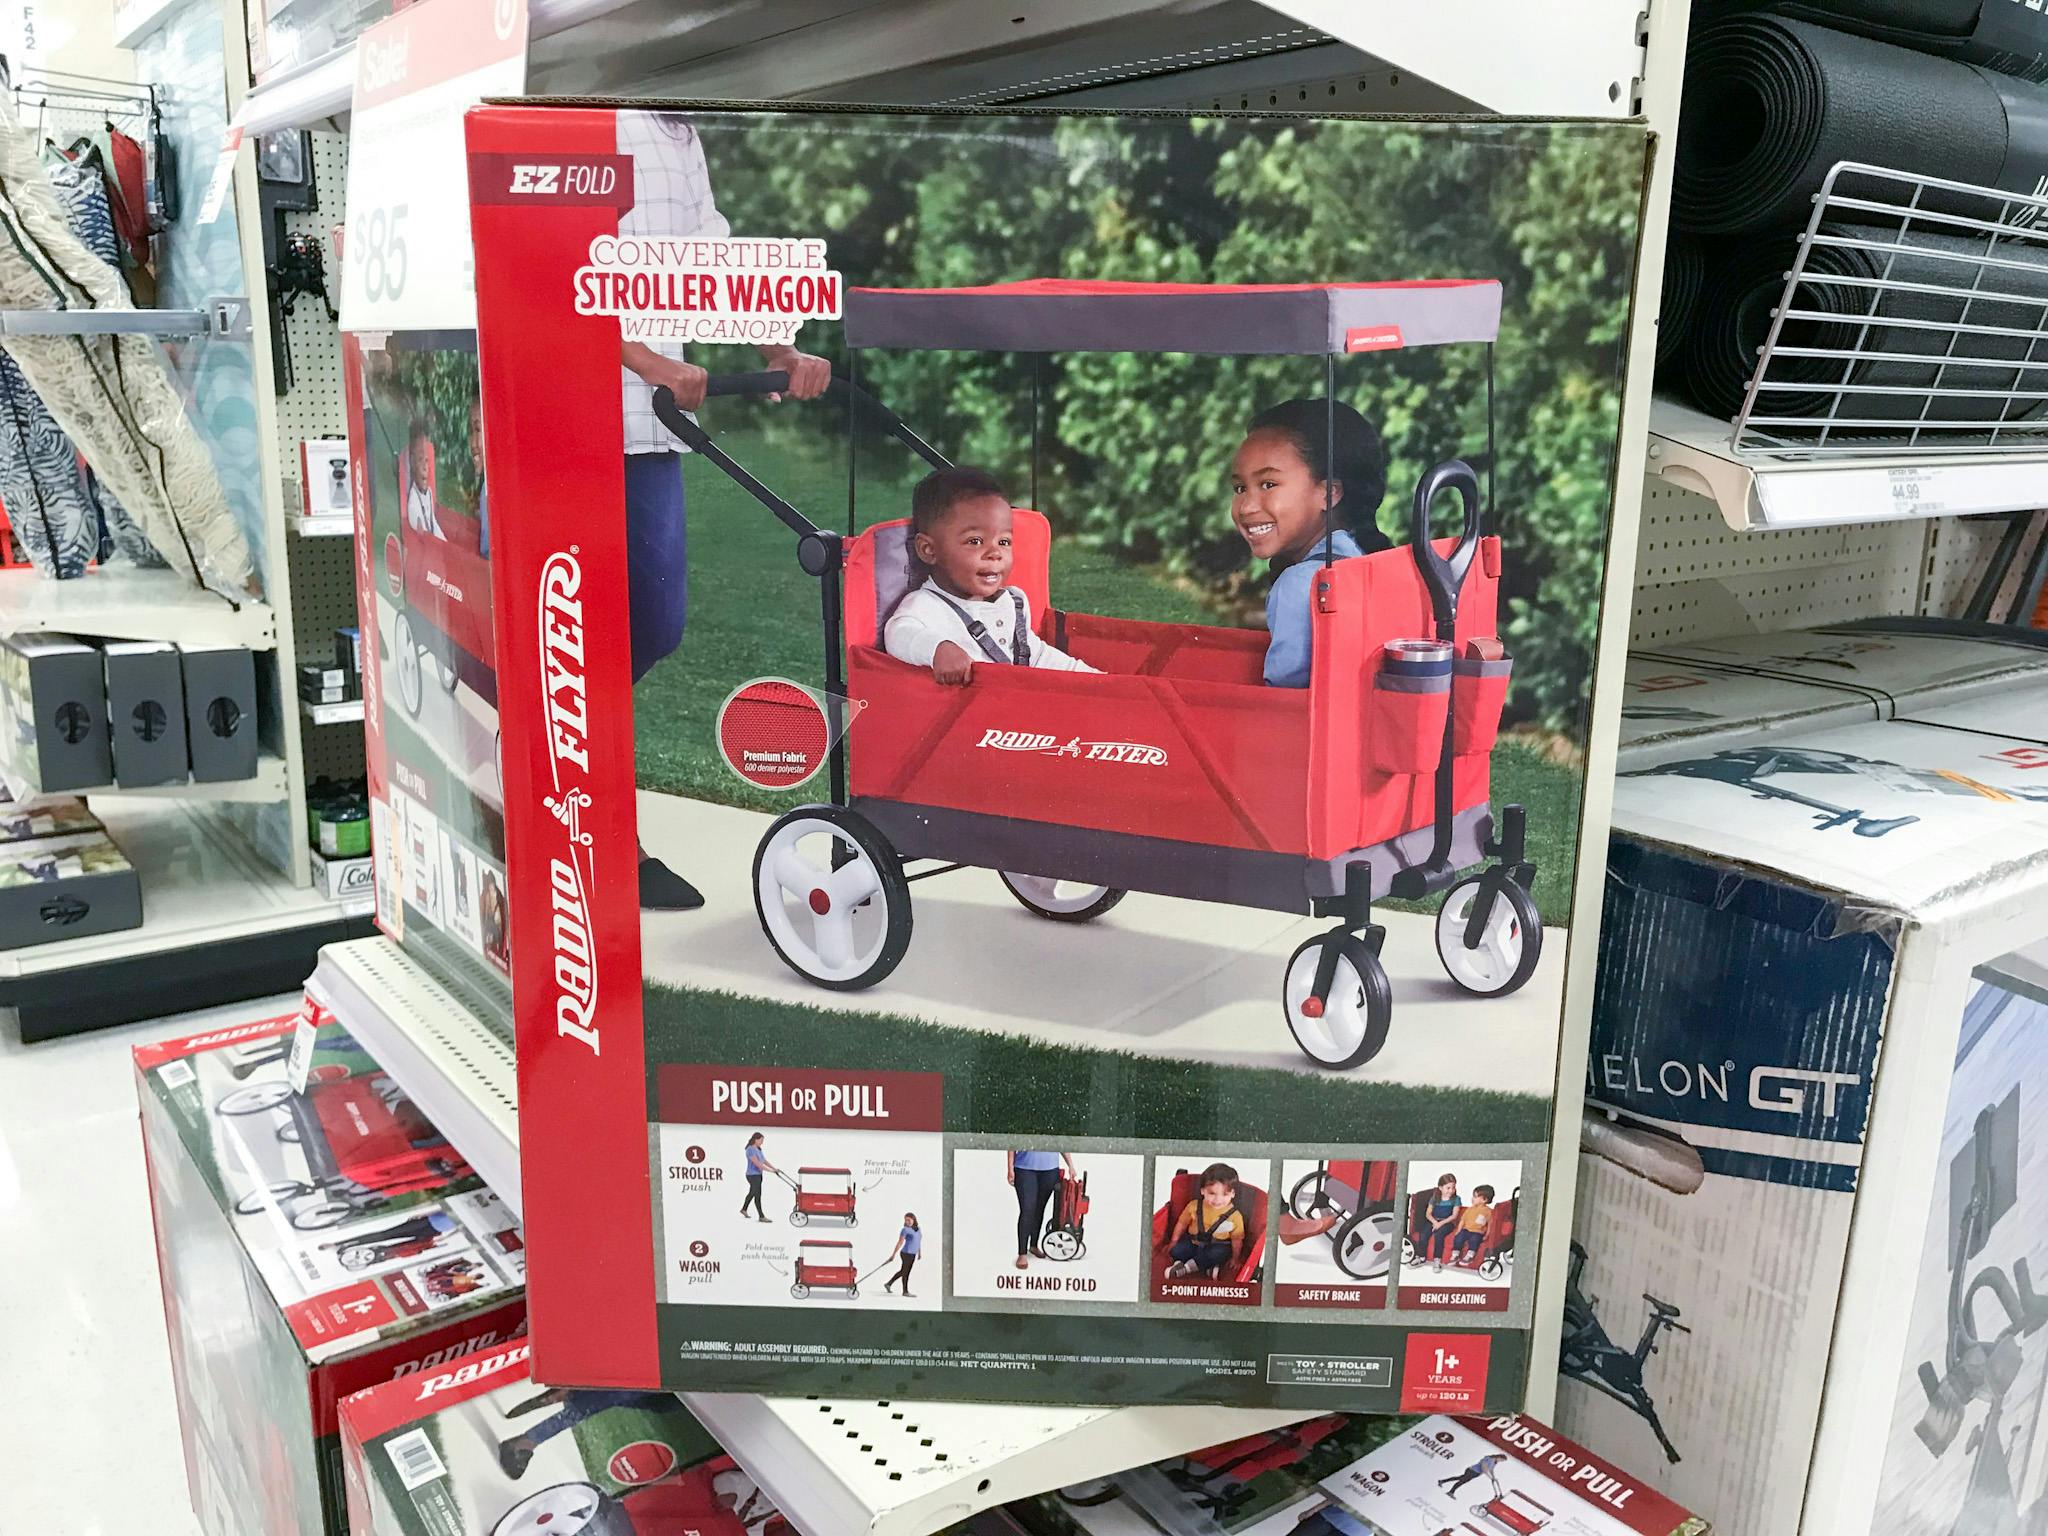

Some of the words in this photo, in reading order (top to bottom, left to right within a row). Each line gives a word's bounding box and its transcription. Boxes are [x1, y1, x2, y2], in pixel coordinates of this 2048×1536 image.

[509, 165, 561, 194] EZ
[564, 166, 616, 195] FOLD
[594, 240, 822, 269] CONVERTIBLE
[580, 272, 717, 311] STROLLER
[726, 275, 836, 314] WAGON
[624, 317, 687, 338] WITH
[695, 319, 797, 340] CANOPY
[539, 552, 589, 775] FLYER
[976, 729, 1056, 750] RADIO
[1085, 743, 1168, 766] FLYER
[744, 750, 780, 762] Premium
[782, 752, 807, 763] Fabric
[744, 763, 757, 771] 600
[758, 763, 778, 773] denier
[778, 764, 806, 774] polyester
[551, 858, 600, 1057] RADIO
[712, 1080, 783, 1114] PUSH
[791, 1088, 816, 1111] OR
[825, 1084, 889, 1117] PULL
[1748, 1066, 1861, 1117] GT
[691, 1149, 699, 1159] 1
[669, 1166, 723, 1181] STROLLER
[681, 1182, 711, 1193] push
[694, 1243, 704, 1254] 2
[679, 1260, 720, 1273] WAGON
[688, 1273, 712, 1285] pull
[996, 1275, 1022, 1290] ONE
[1026, 1277, 1062, 1291] HAND
[1066, 1279, 1097, 1292] FOLD
[1162, 1285, 1198, 1297] 5-POINT
[1200, 1286, 1249, 1298] HARNESSES
[1299, 1289, 1330, 1301] SAFETY
[1332, 1290, 1361, 1302] BRAKE
[1420, 1293, 1449, 1304] BENCH
[1451, 1293, 1487, 1305] SEATING
[691, 1340, 732, 1352] WARNING:
[734, 1343, 756, 1353] ADULT
[757, 1344, 792, 1354] ASSEMBLY
[793, 1345, 829, 1355] REQUIRED.
[980, 1361, 1030, 1370] QUANTITY:
[1296, 1360, 1316, 1368] TOY
[1327, 1361, 1380, 1371] STROLLER
[1434, 1348, 1460, 1374] 1+
[1205, 1367, 1232, 1375] MODEL
[1324, 1368, 1367, 1376] STANDARD
[1428, 1375, 1463, 1385] YEARS
[1410, 1431, 1455, 1460] STROLLER
[1487, 1416, 1555, 1458] PUSH
[1549, 1451, 1576, 1472] OR
[1570, 1464, 1634, 1509] PULL
[1350, 1471, 1386, 1496] WAGON
